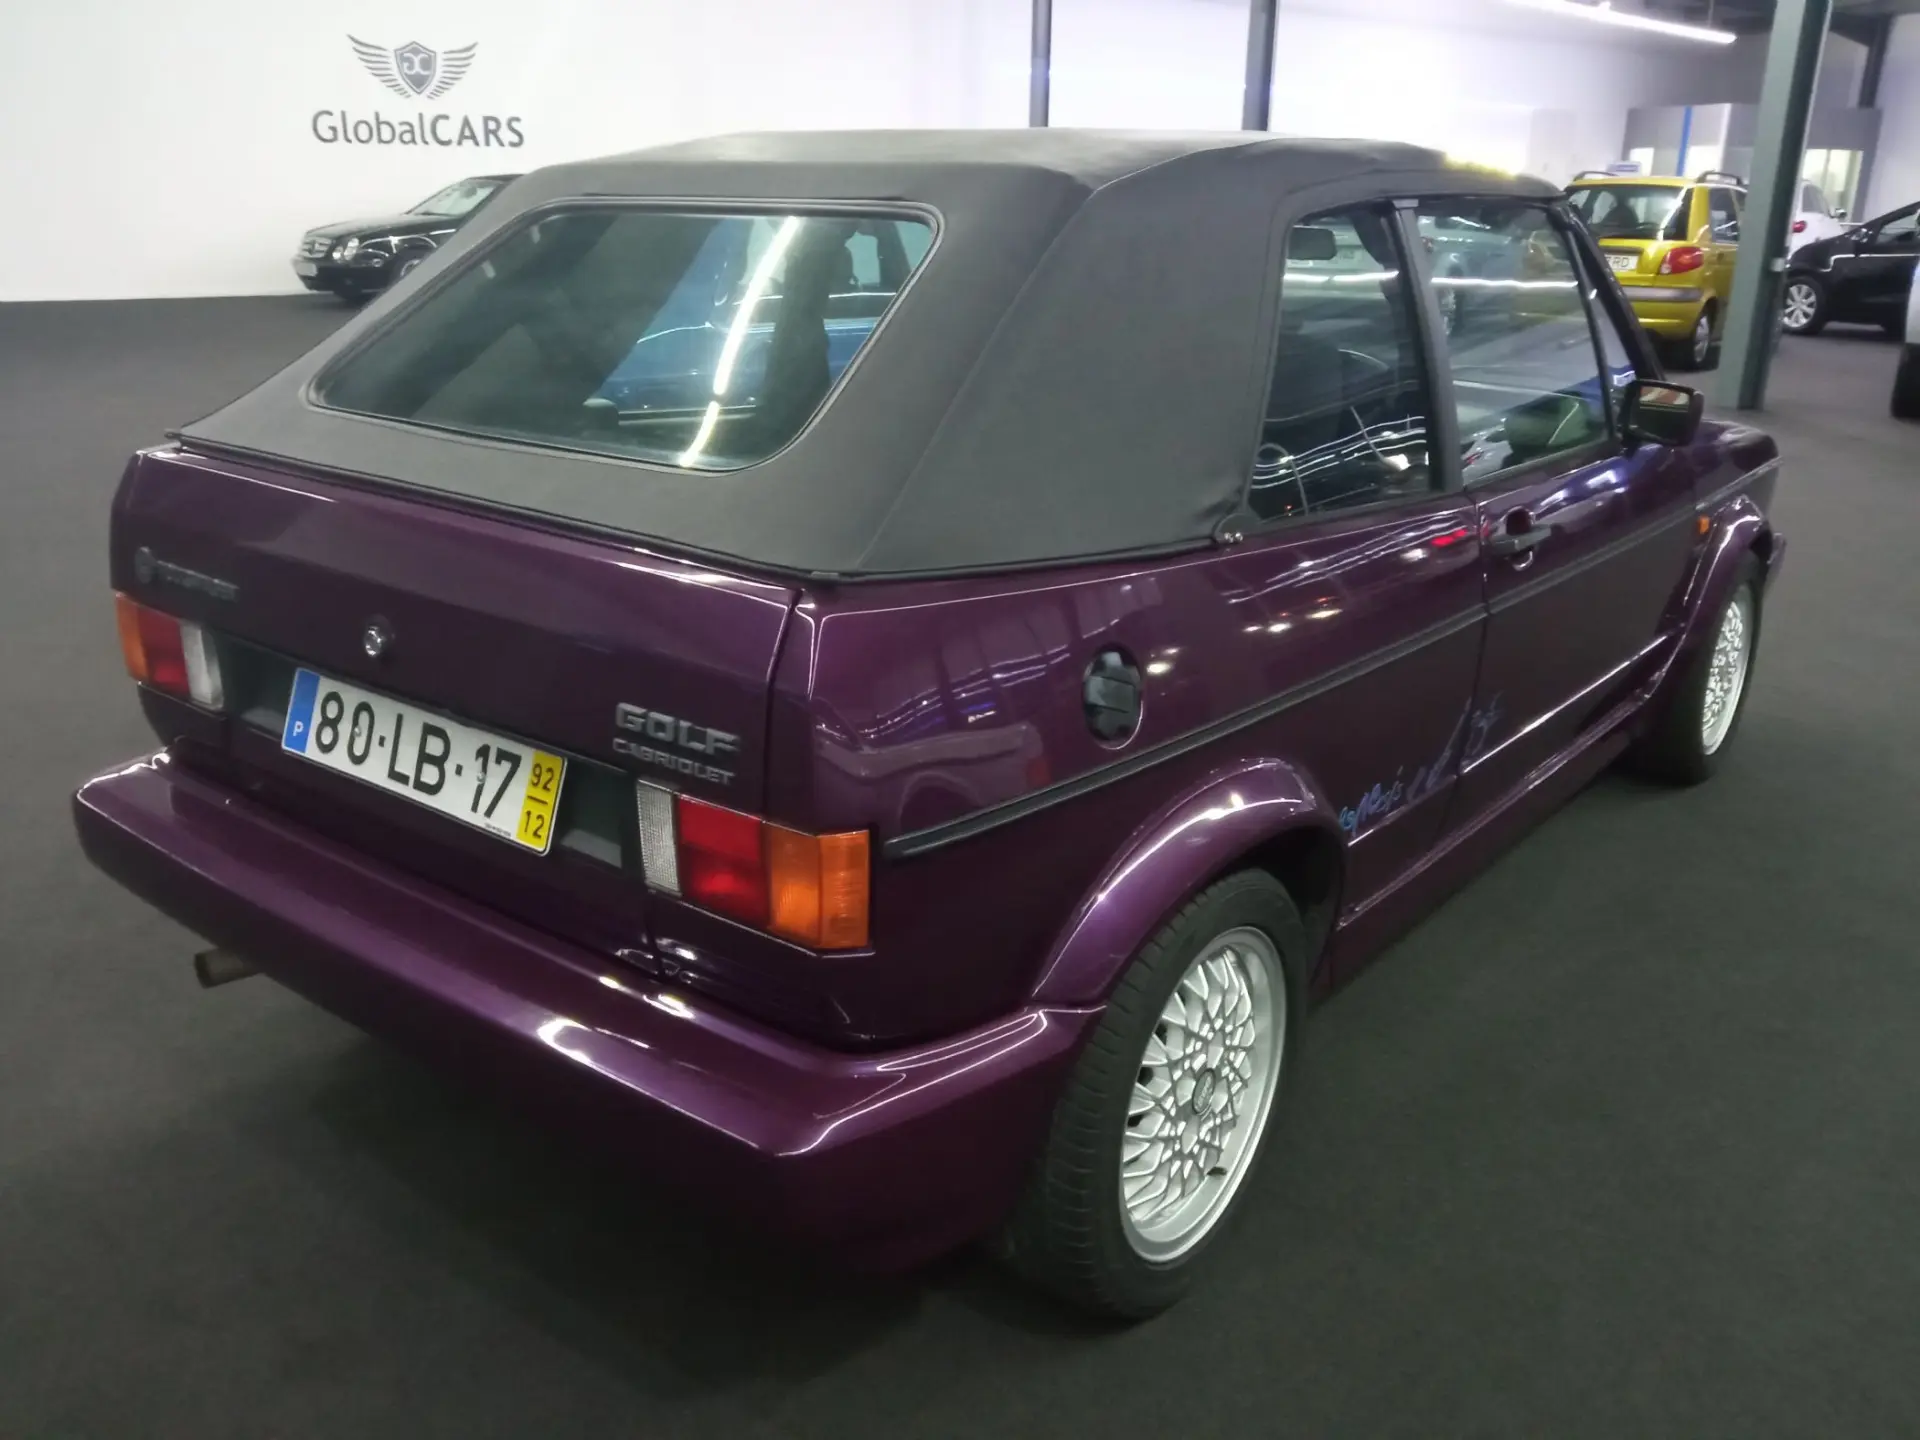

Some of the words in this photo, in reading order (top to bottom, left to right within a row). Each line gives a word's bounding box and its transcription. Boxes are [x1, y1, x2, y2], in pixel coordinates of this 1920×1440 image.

[312, 109, 524, 148] GlobalCARS
[293, 721, 304, 737] P
[616, 702, 740, 754] GOLF
[531, 763, 554, 792] 92
[523, 809, 546, 839] 12
